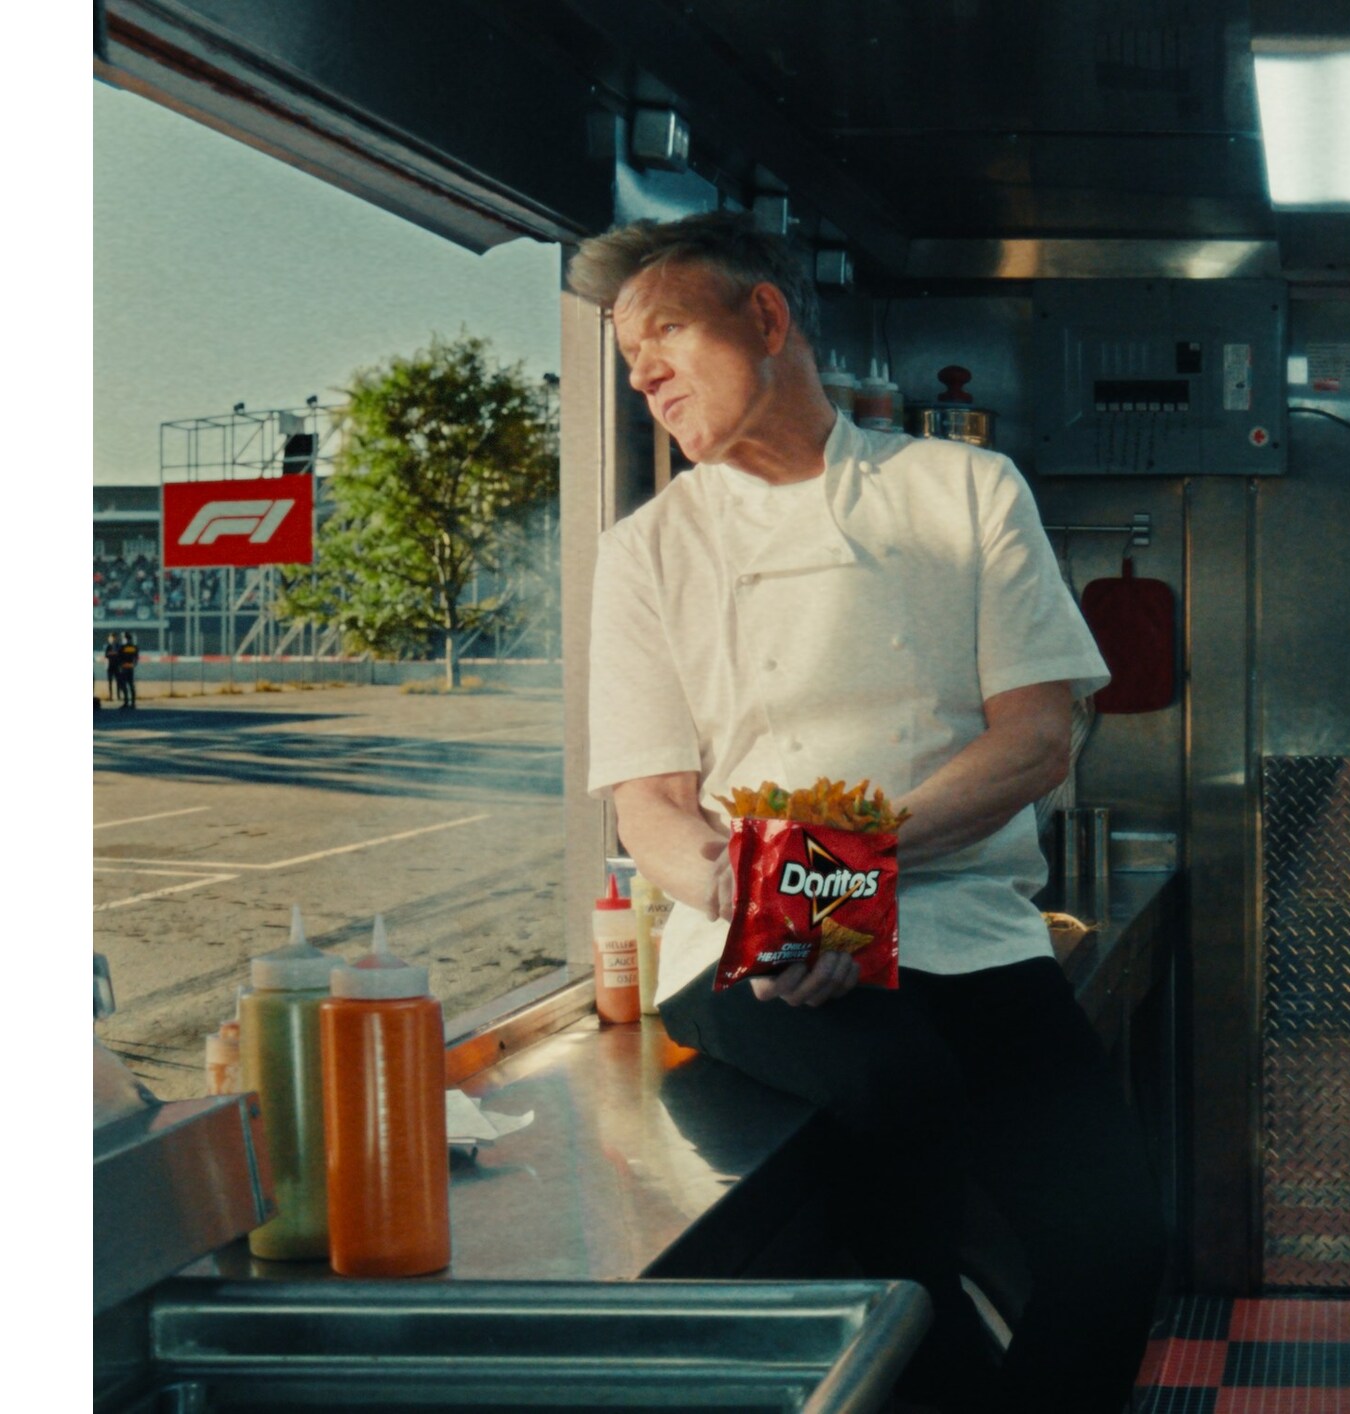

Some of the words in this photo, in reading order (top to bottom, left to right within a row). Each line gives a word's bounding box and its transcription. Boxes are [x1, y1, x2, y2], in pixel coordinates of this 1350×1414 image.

[178, 499, 295, 544] F1
[780, 862, 880, 898] Doritos
[756, 950, 811, 963] HEATWAVE
